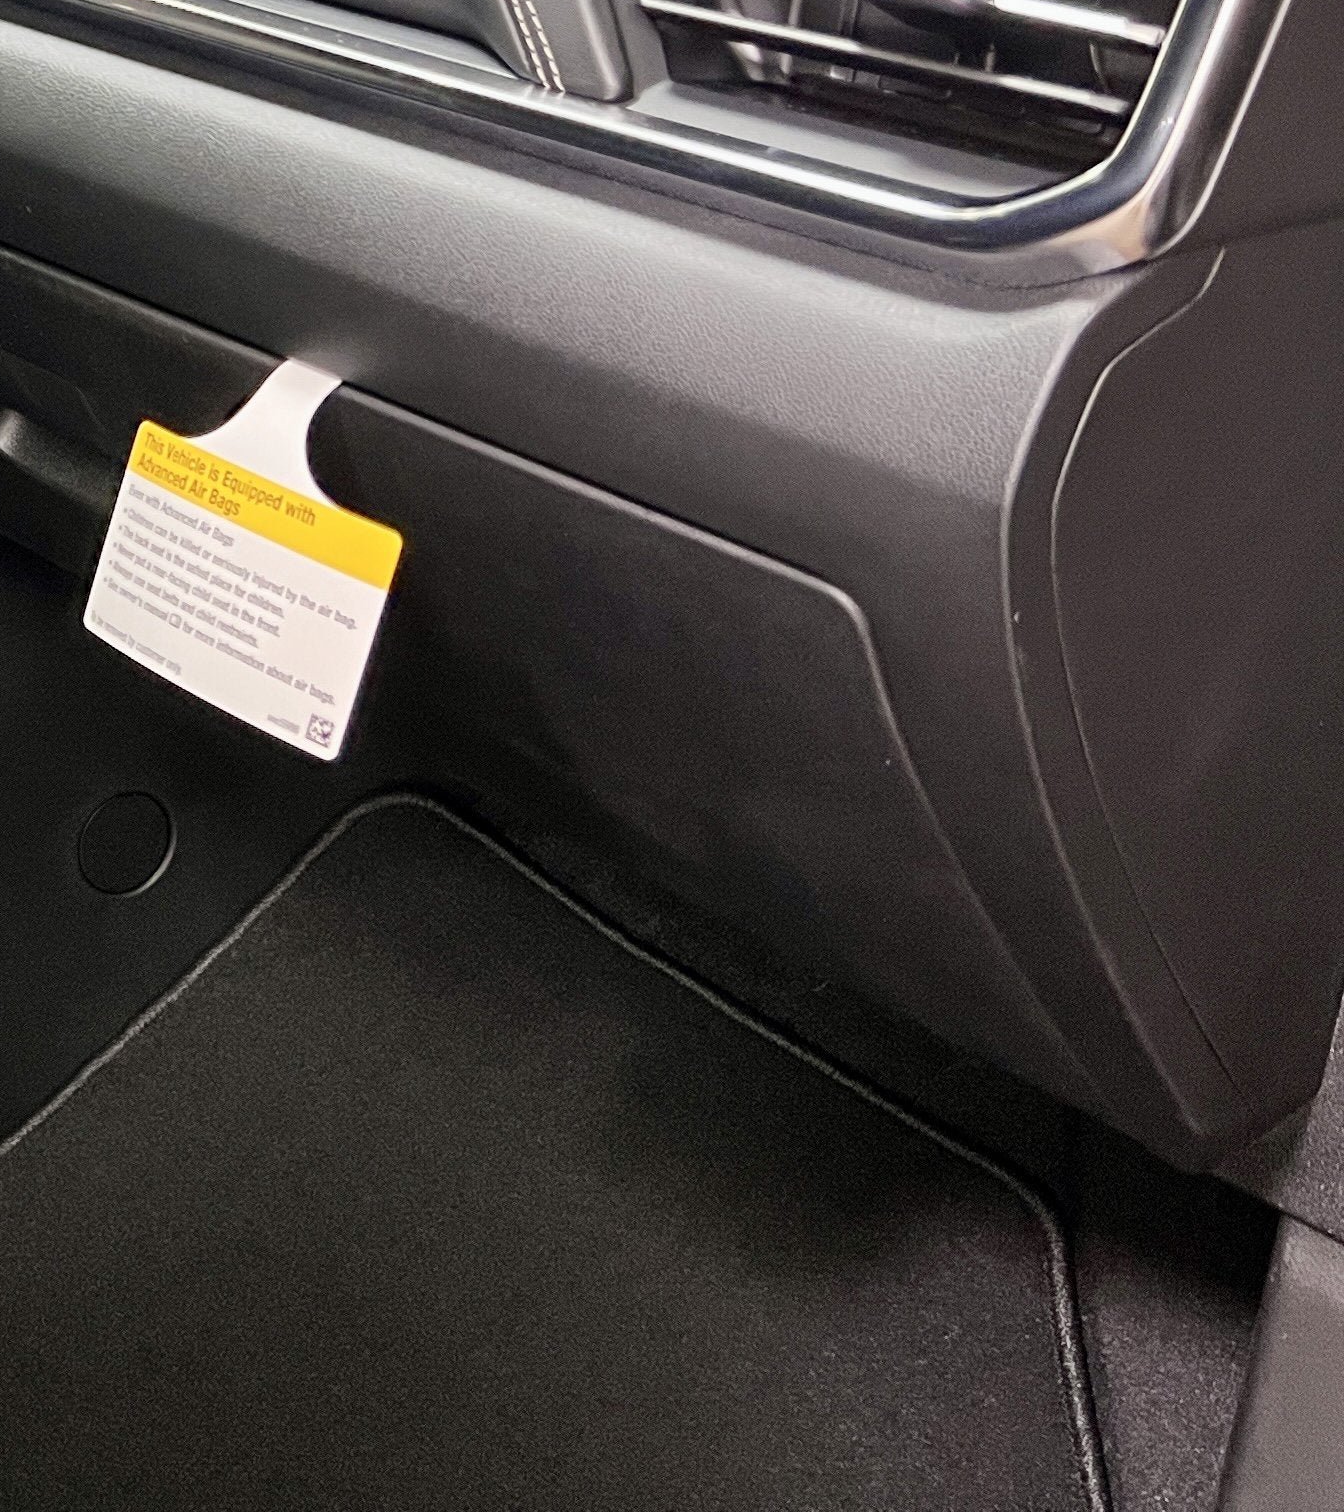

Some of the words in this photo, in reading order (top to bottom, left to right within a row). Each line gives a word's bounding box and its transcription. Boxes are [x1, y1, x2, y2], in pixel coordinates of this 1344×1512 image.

[137, 453, 189, 490] Advanced
[189, 479, 209, 499] Air
[208, 488, 241, 516] Bags
[144, 432, 165, 455] This
[166, 443, 206, 475] Vehicle
[222, 471, 284, 511] Equipped
[285, 502, 316, 527] with
